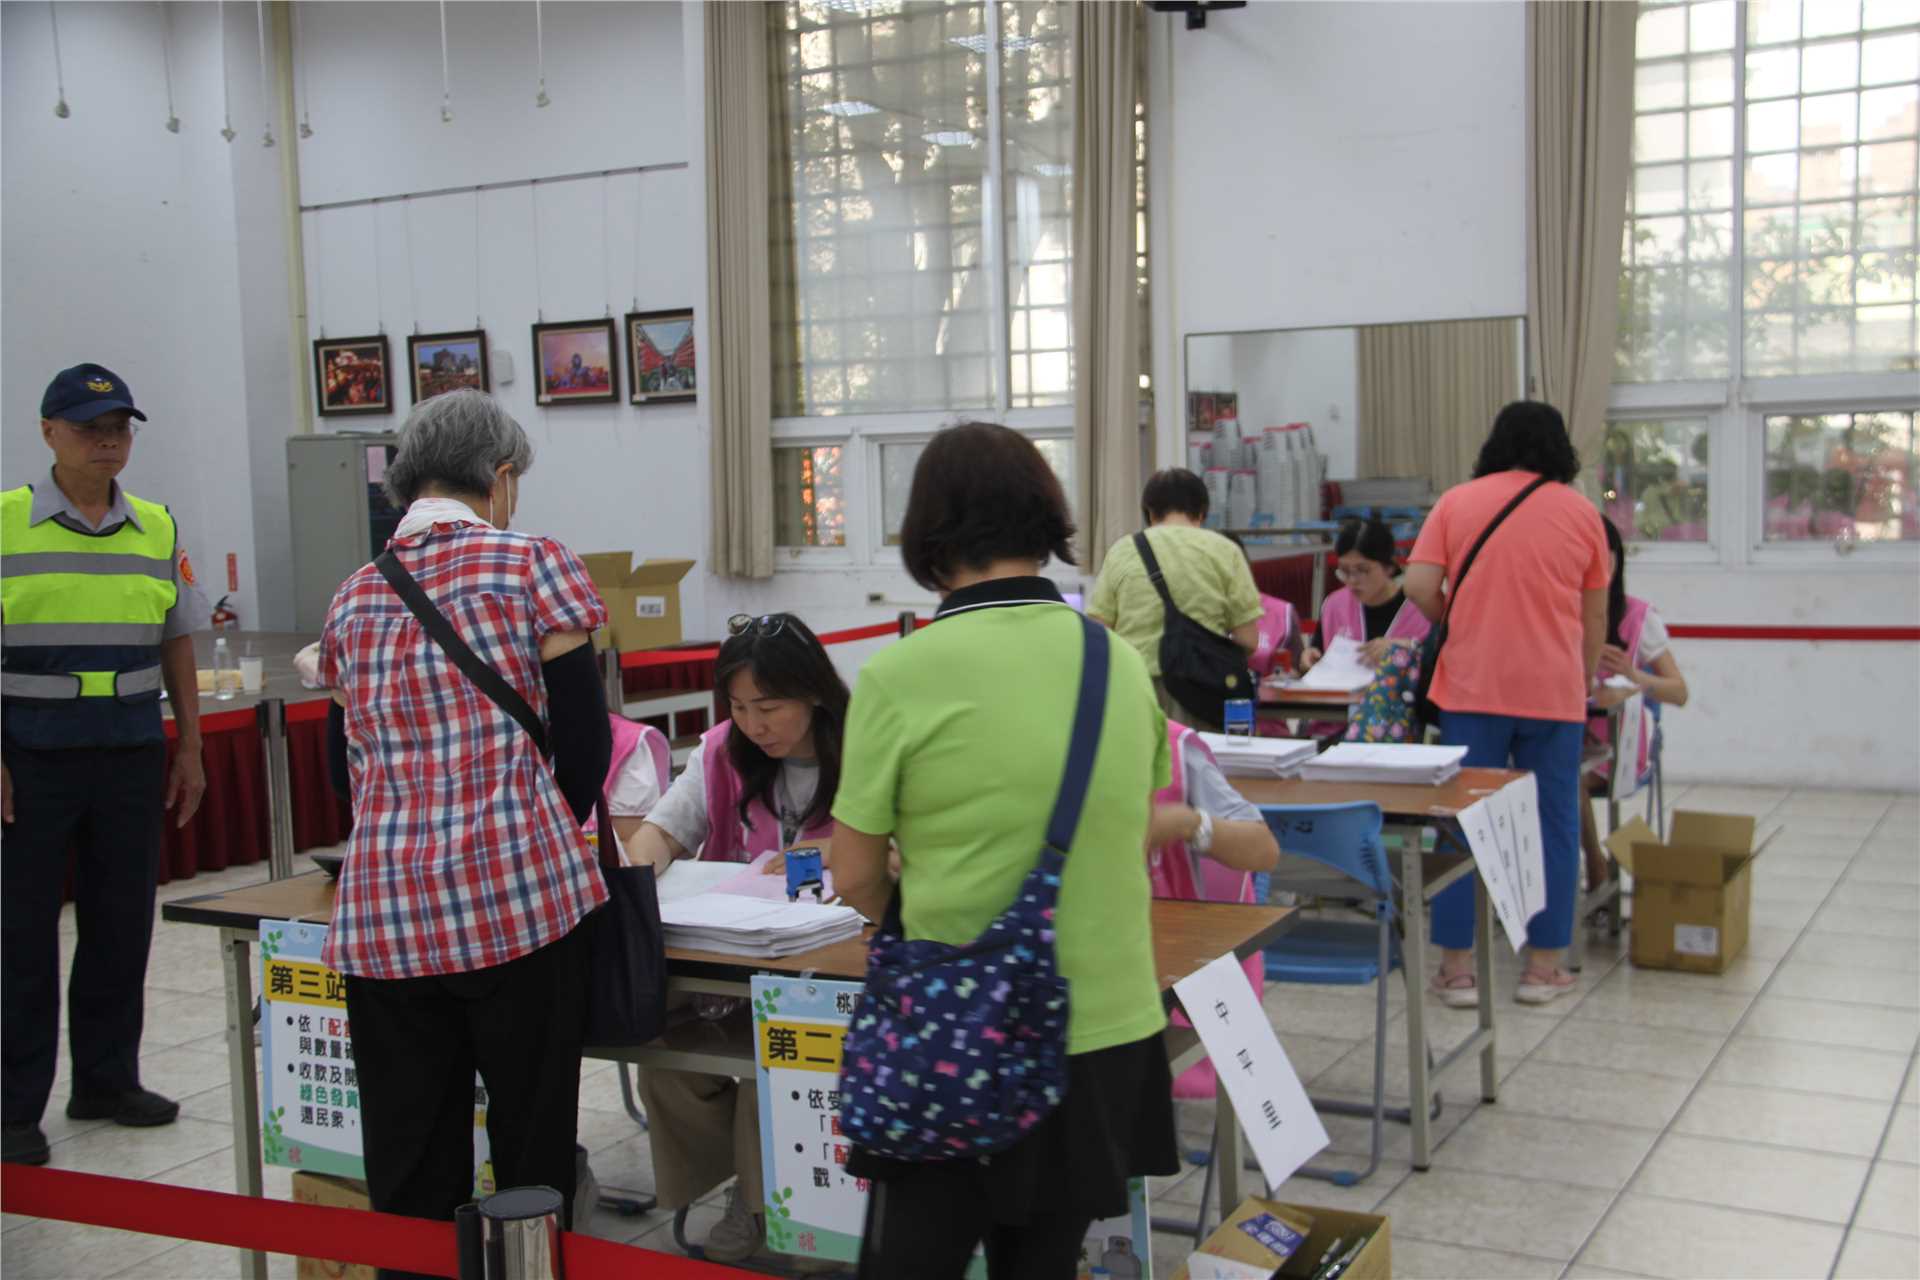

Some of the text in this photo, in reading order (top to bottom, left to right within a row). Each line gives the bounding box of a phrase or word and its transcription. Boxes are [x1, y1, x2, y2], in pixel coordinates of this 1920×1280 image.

[270, 964, 346, 1001] 第三站
[836, 992, 863, 1014] 桃
[767, 1026, 845, 1063] 第二
